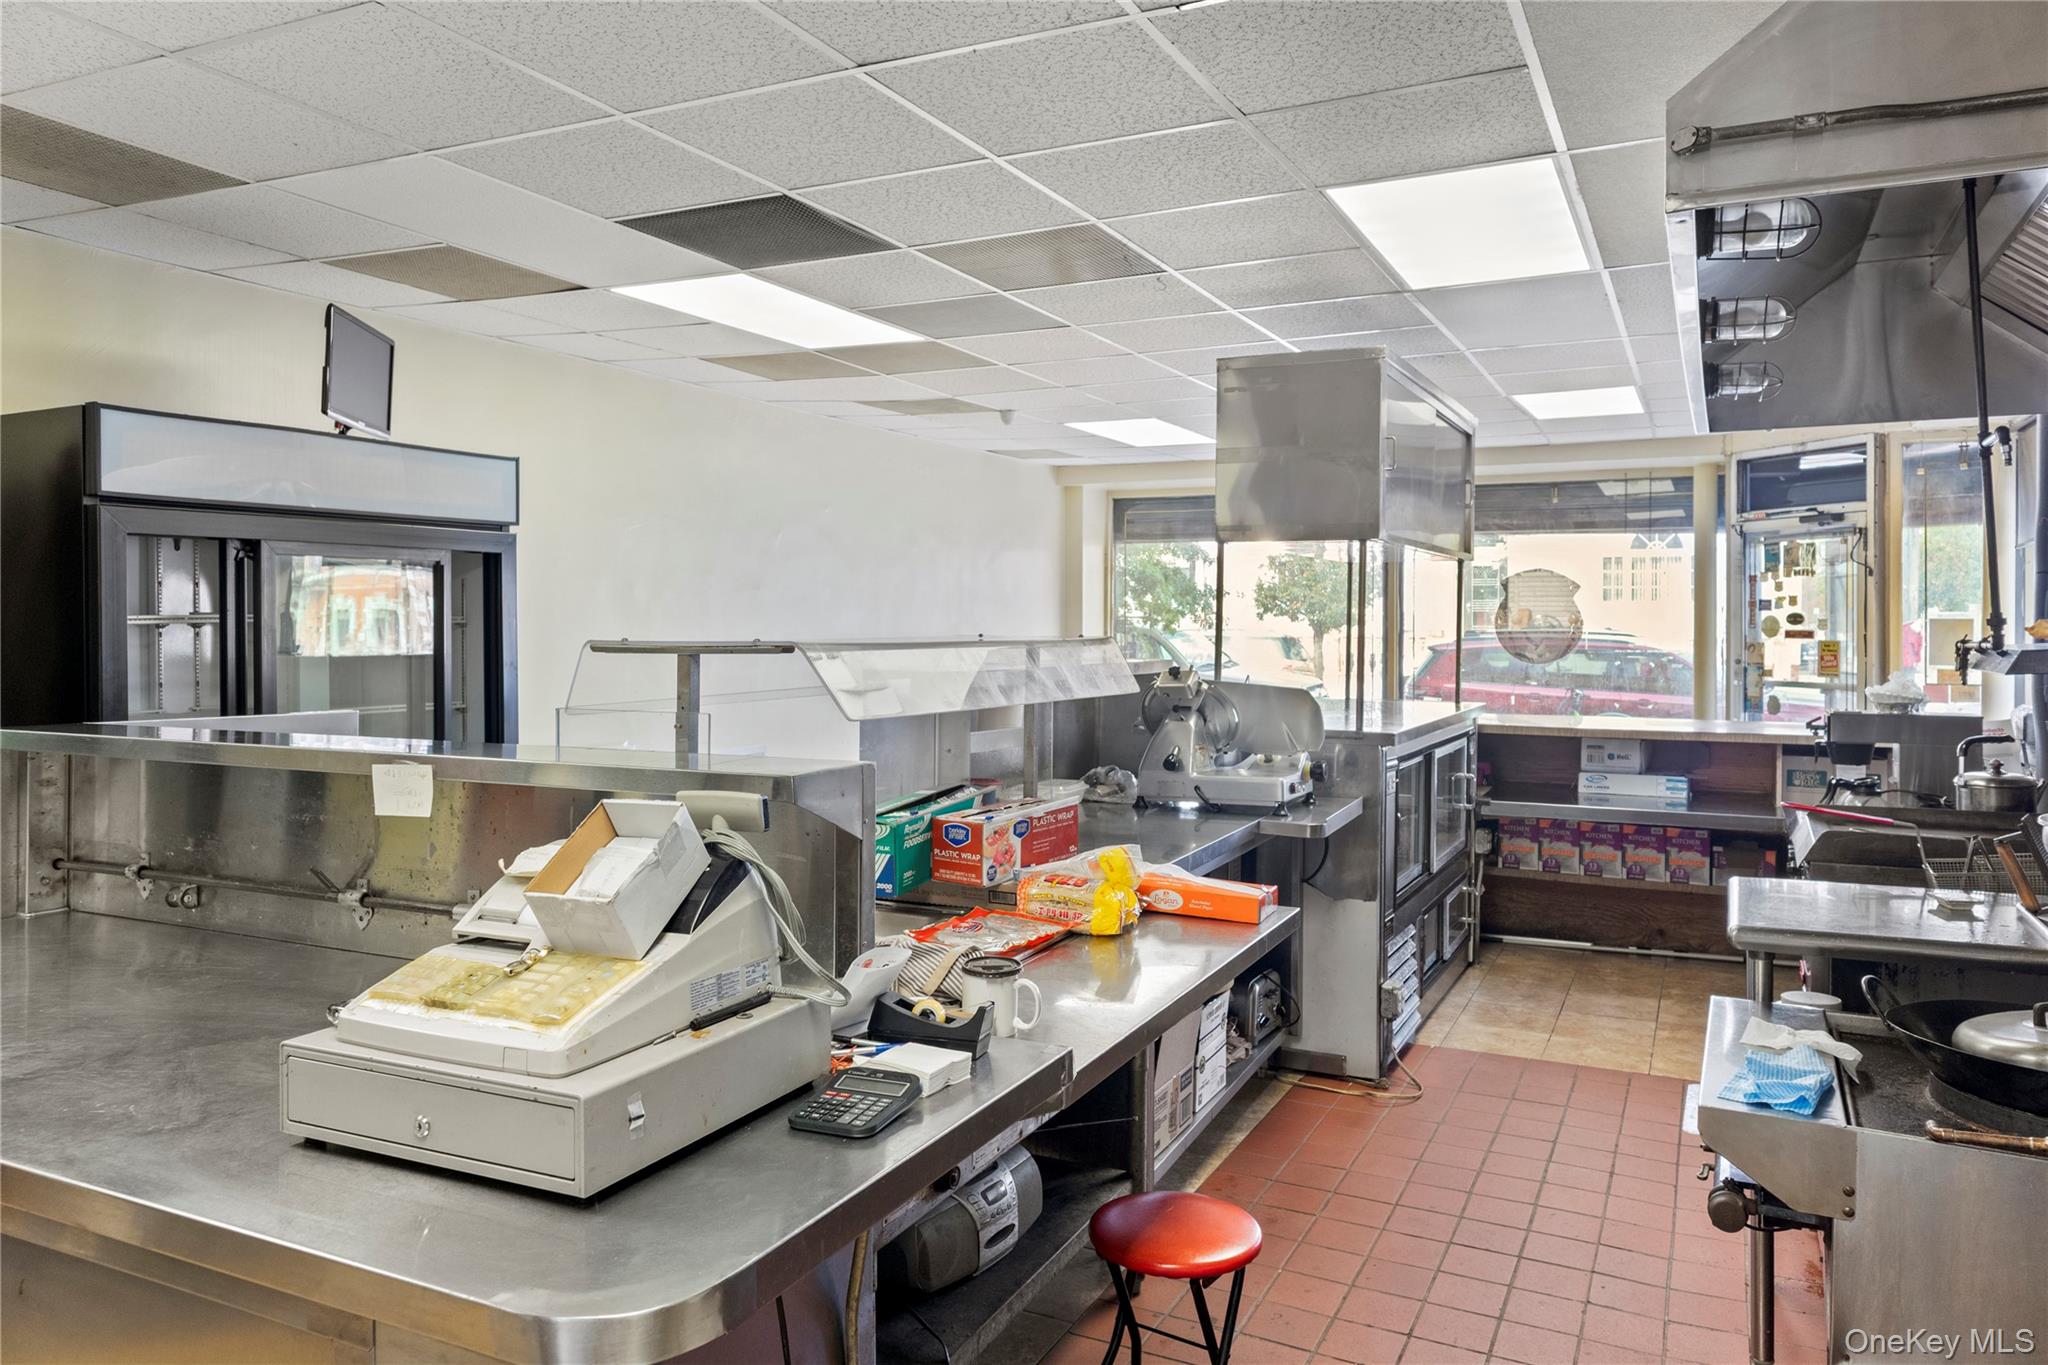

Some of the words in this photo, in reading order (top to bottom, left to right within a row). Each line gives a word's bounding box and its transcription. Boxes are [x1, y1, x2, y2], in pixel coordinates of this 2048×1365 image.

[1033, 813, 1056, 827] PLASTIC
[1057, 810, 1075, 820] WRAP
[934, 848, 959, 858] PLASTIC
[961, 852, 981, 861] WRAP
